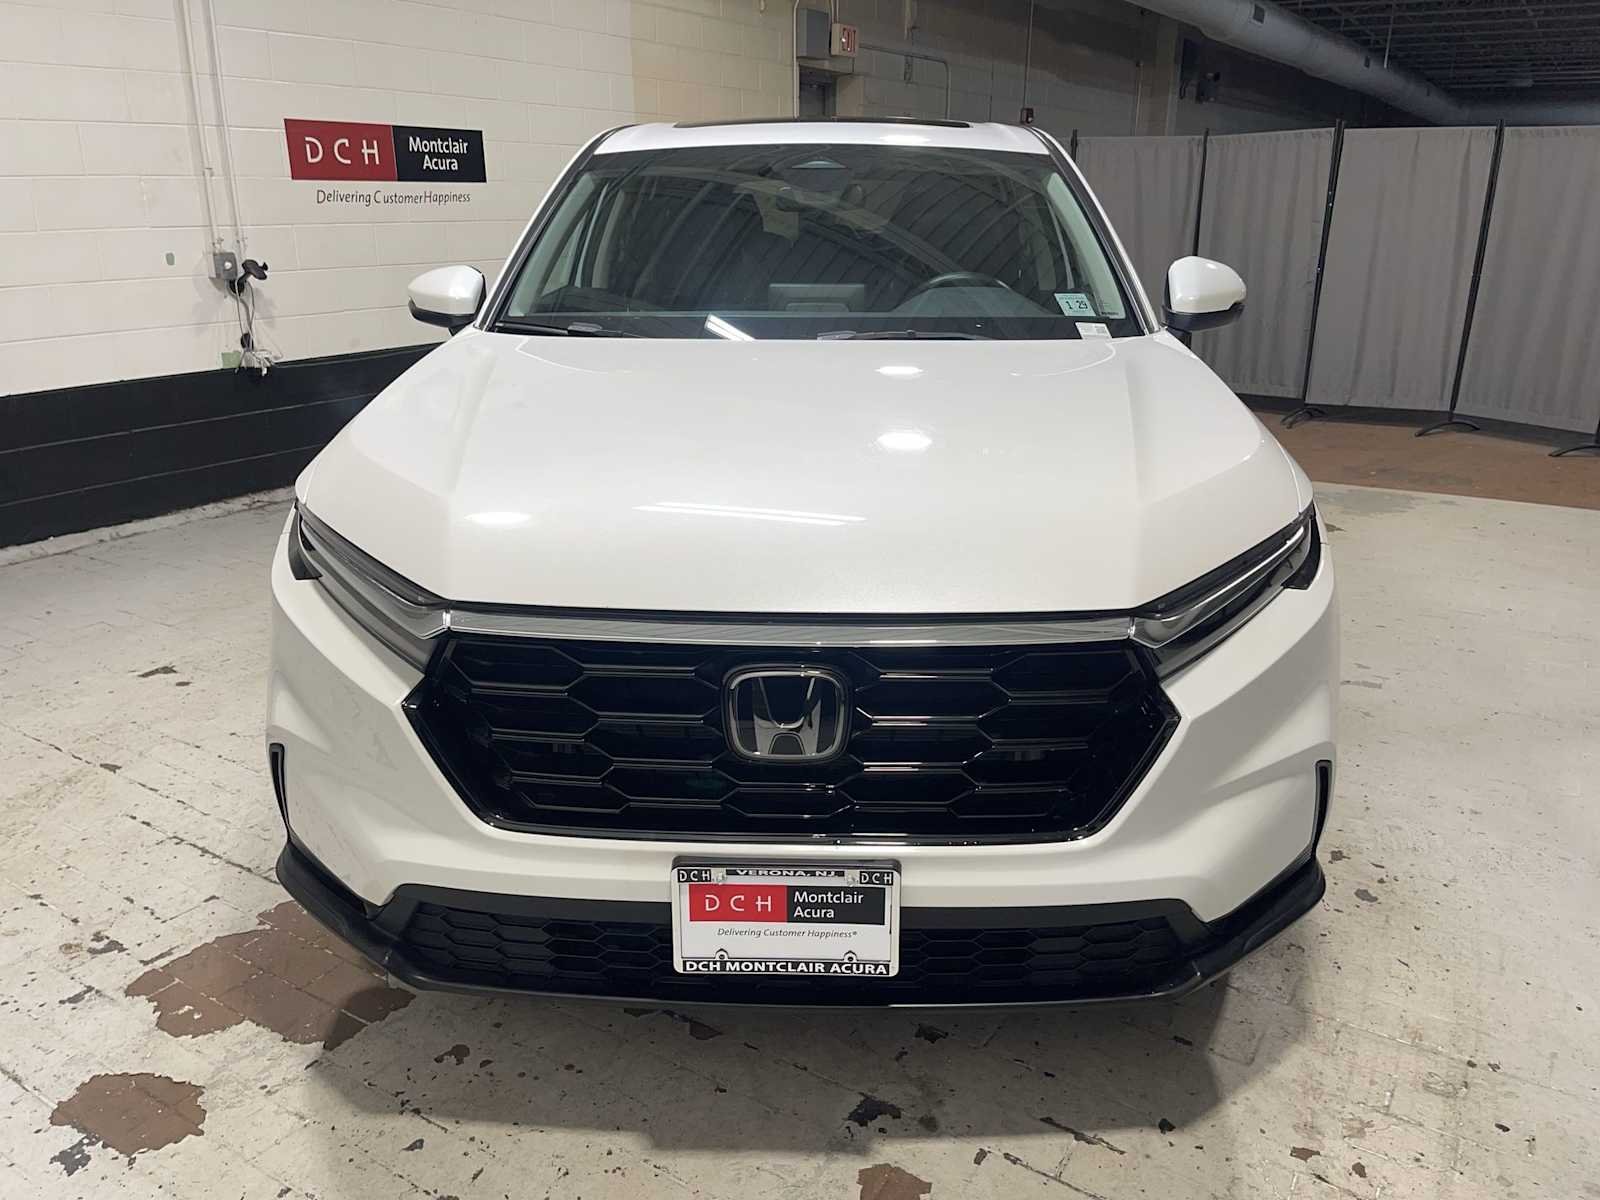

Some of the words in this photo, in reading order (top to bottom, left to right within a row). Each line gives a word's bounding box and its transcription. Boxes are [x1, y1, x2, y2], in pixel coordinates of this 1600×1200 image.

[408, 136, 469, 154] Montclair
[422, 155, 459, 171] Acura
[316, 189, 371, 207] Delivering
[424, 190, 471, 206] Happiness
[679, 870, 711, 882] DCH
[861, 872, 892, 884] DCH
[793, 891, 864, 904] Montclair
[793, 906, 835, 918] Acura
[717, 928, 761, 938] Delivering
[763, 929, 805, 937] Customer
[685, 961, 721, 972] DCH
[725, 961, 825, 973] MONTCLAIR
[830, 963, 887, 974] ACURA
